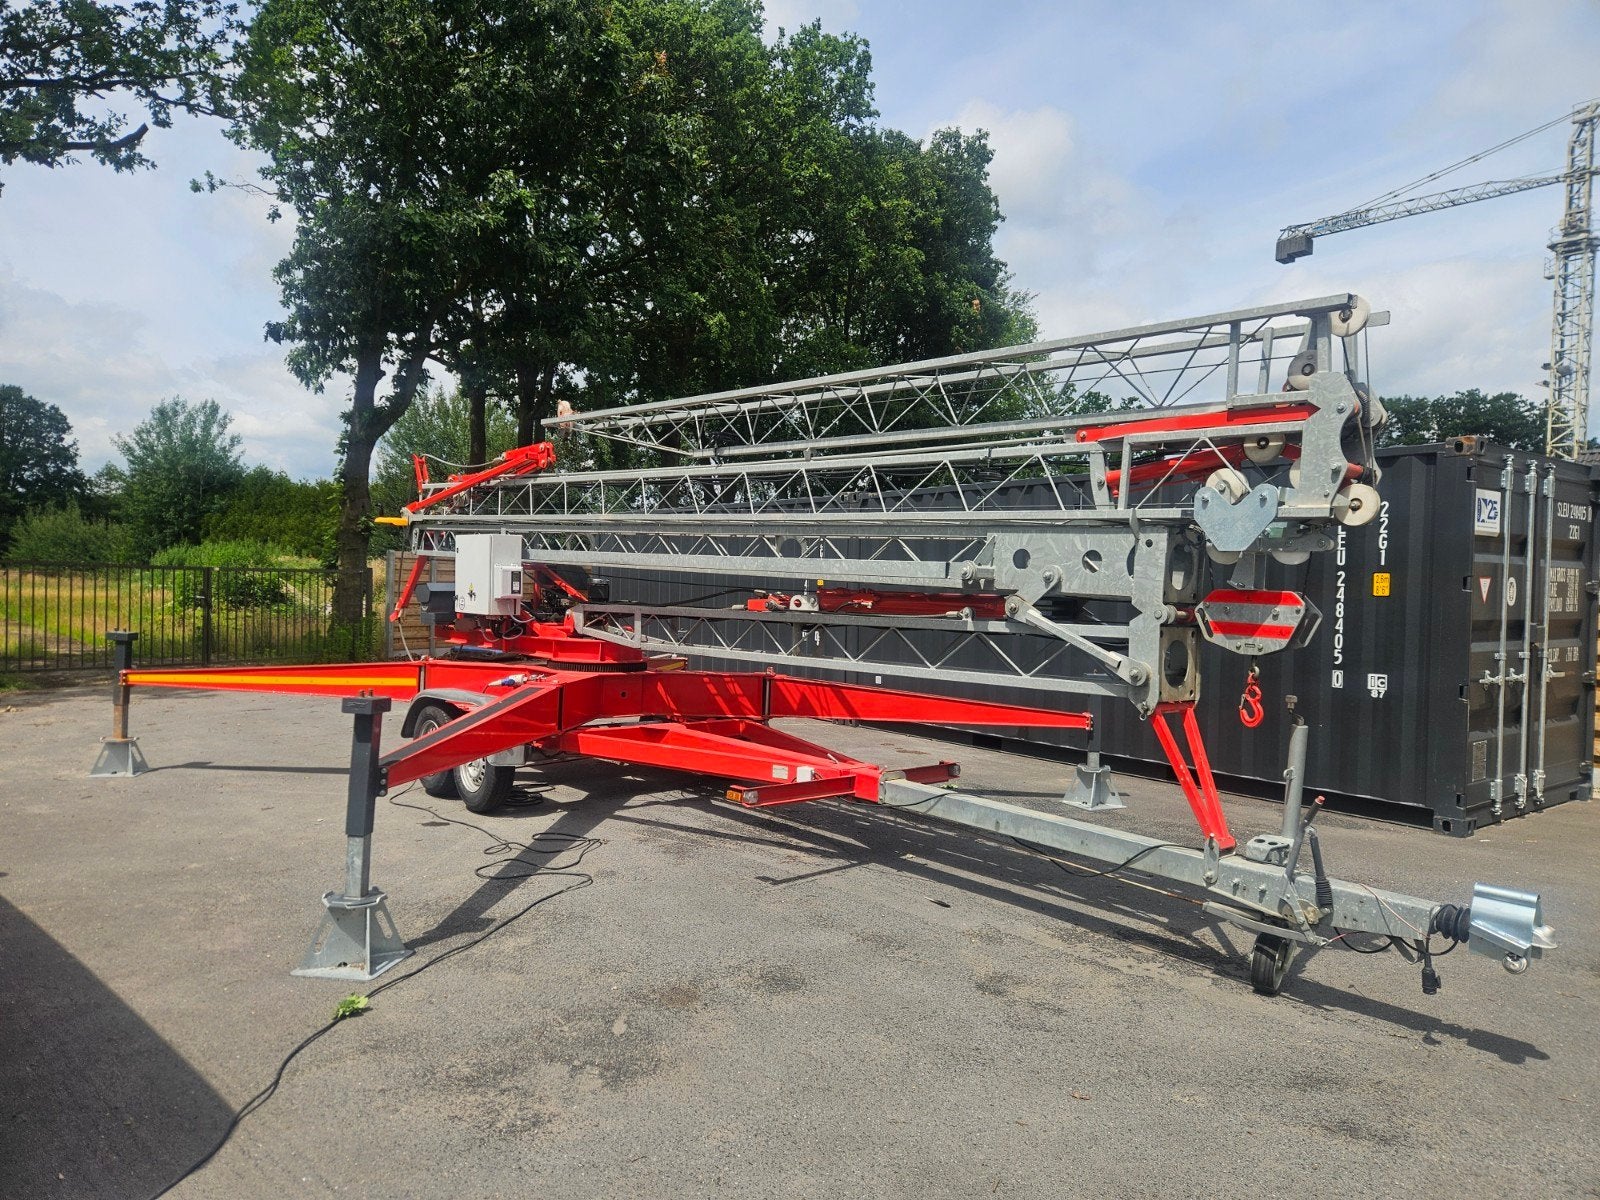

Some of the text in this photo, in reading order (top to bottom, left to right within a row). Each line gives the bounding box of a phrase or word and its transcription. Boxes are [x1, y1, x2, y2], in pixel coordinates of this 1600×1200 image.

[1378, 501, 1389, 566] 22G1
[1333, 571, 1346, 665] 248405
[1370, 689, 1386, 699] 87
